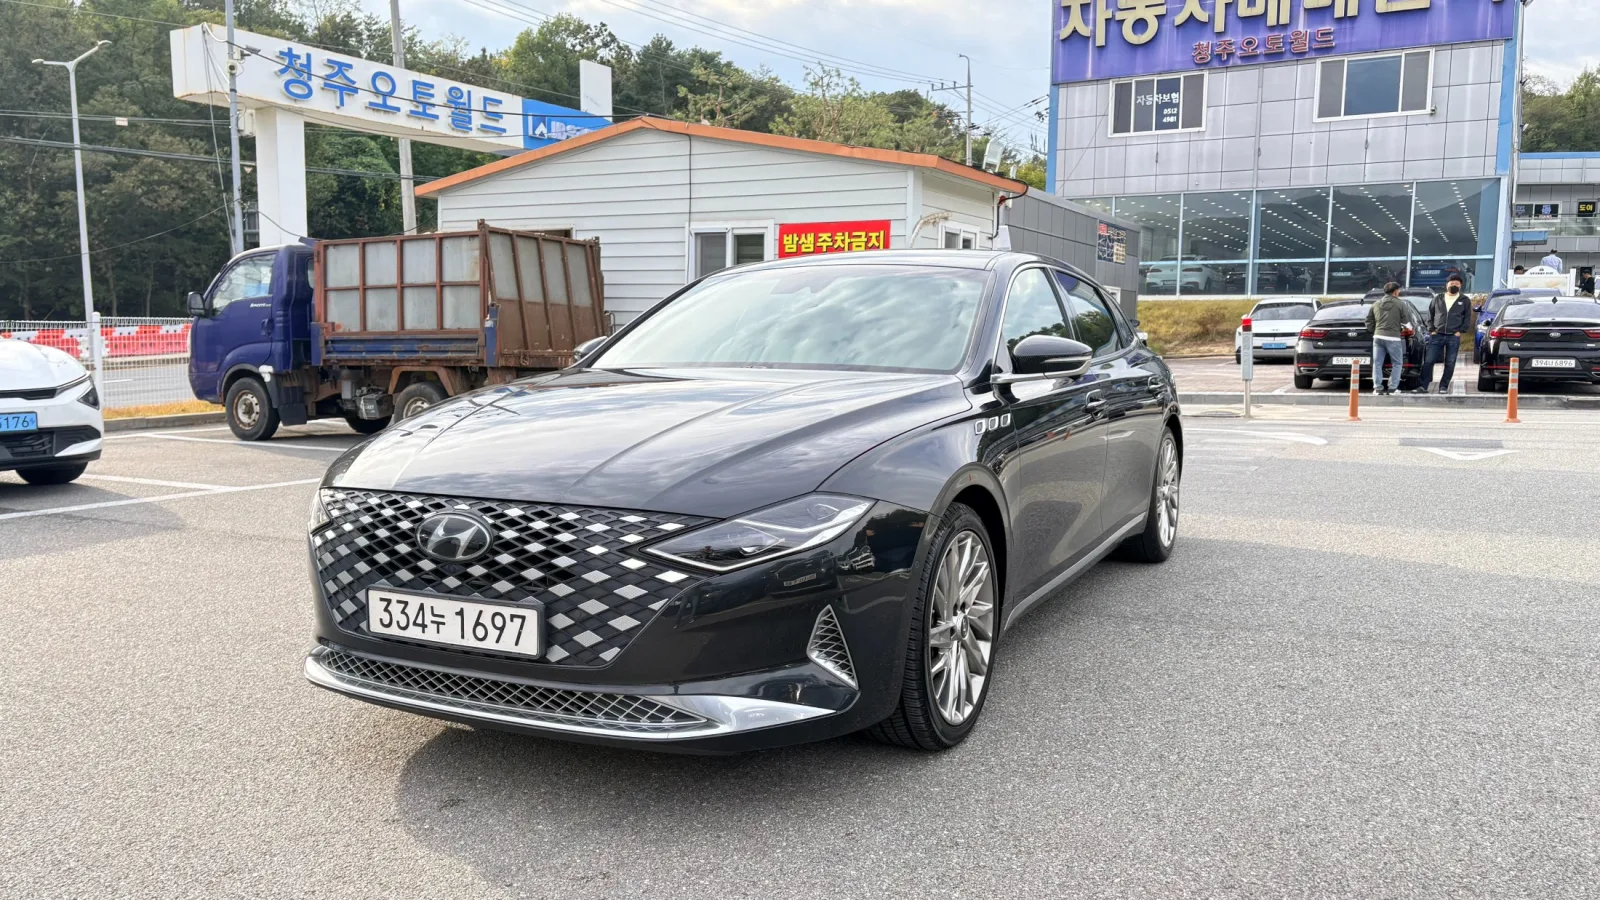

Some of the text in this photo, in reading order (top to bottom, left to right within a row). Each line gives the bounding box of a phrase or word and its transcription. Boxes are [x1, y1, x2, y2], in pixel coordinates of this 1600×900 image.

[1192, 27, 1336, 64] 청주오토월드
[278, 47, 507, 134] 청주오토월드
[0, 416, 29, 429] 176
[455, 607, 527, 647] 1697
